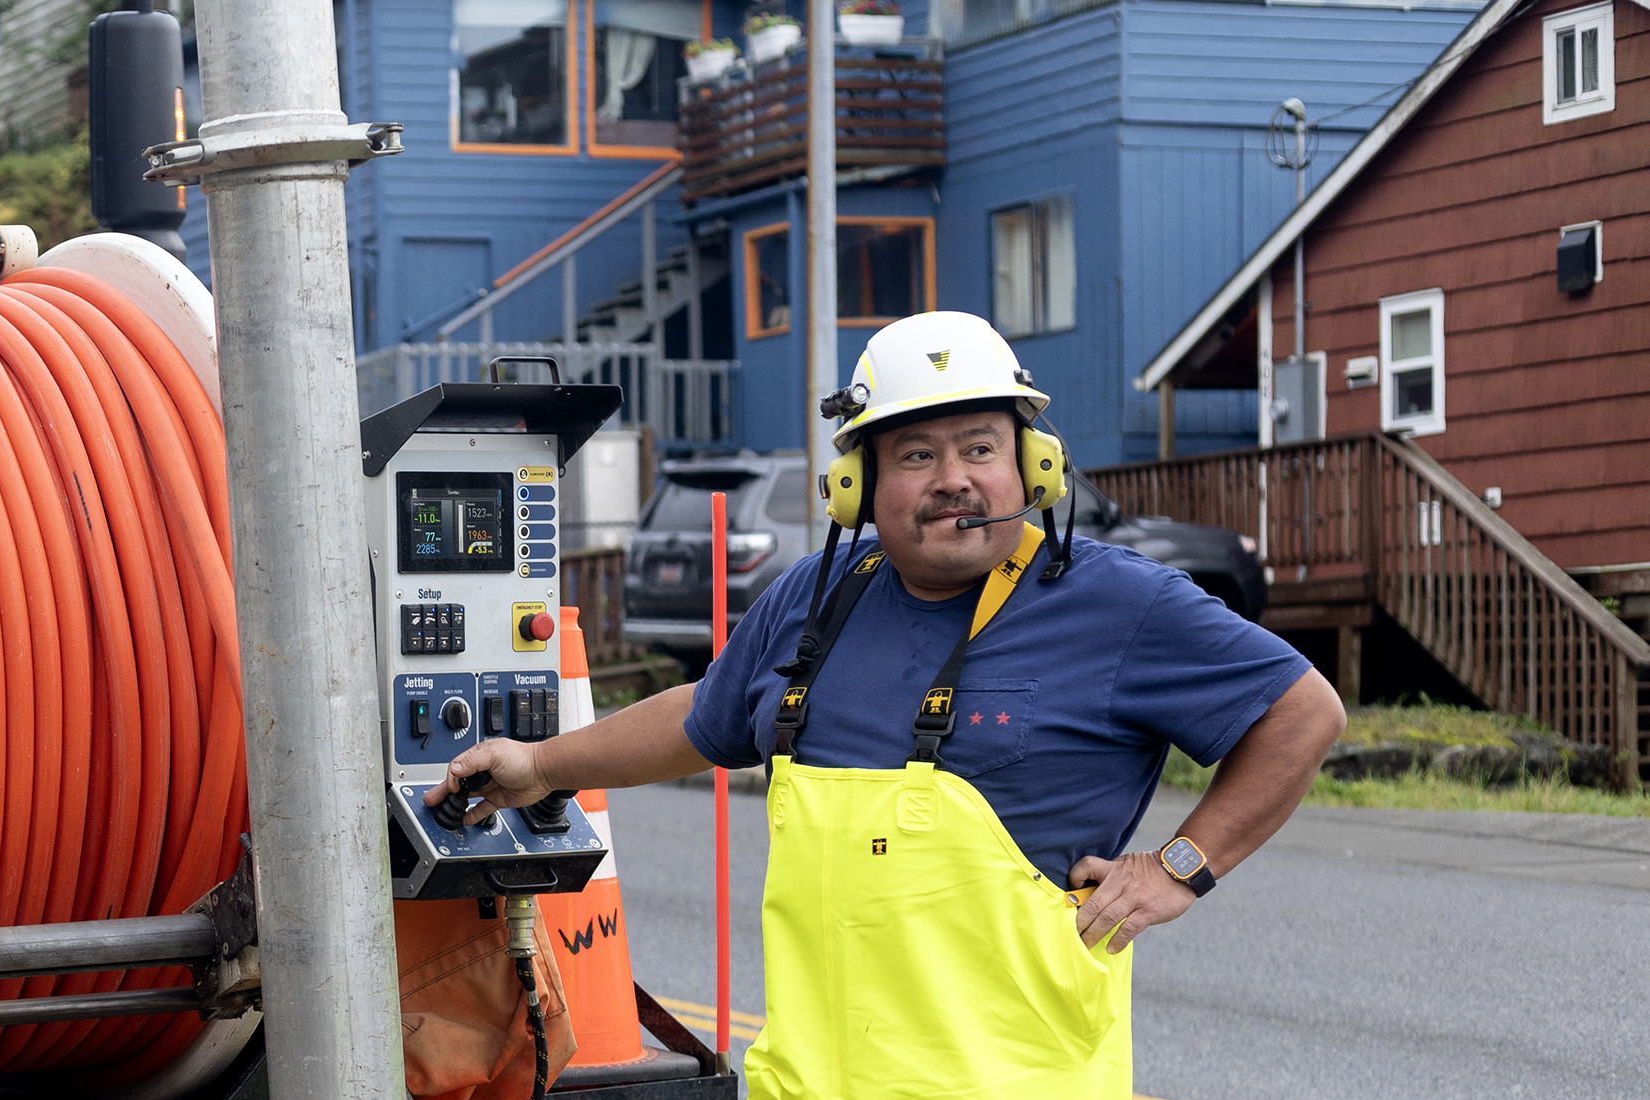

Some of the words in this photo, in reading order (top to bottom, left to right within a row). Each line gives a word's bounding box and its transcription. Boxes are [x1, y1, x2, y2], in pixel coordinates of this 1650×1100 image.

[414, 513, 435, 523] -11.0
[468, 508, 486, 518] 1523
[425, 532, 435, 542] 77
[468, 530, 487, 540] 1963
[416, 544, 436, 554] 2285
[475, 546, 487, 554] -5.3
[418, 588, 441, 600] Setup
[404, 677, 433, 689] Jetting
[515, 674, 546, 685] Vacuum
